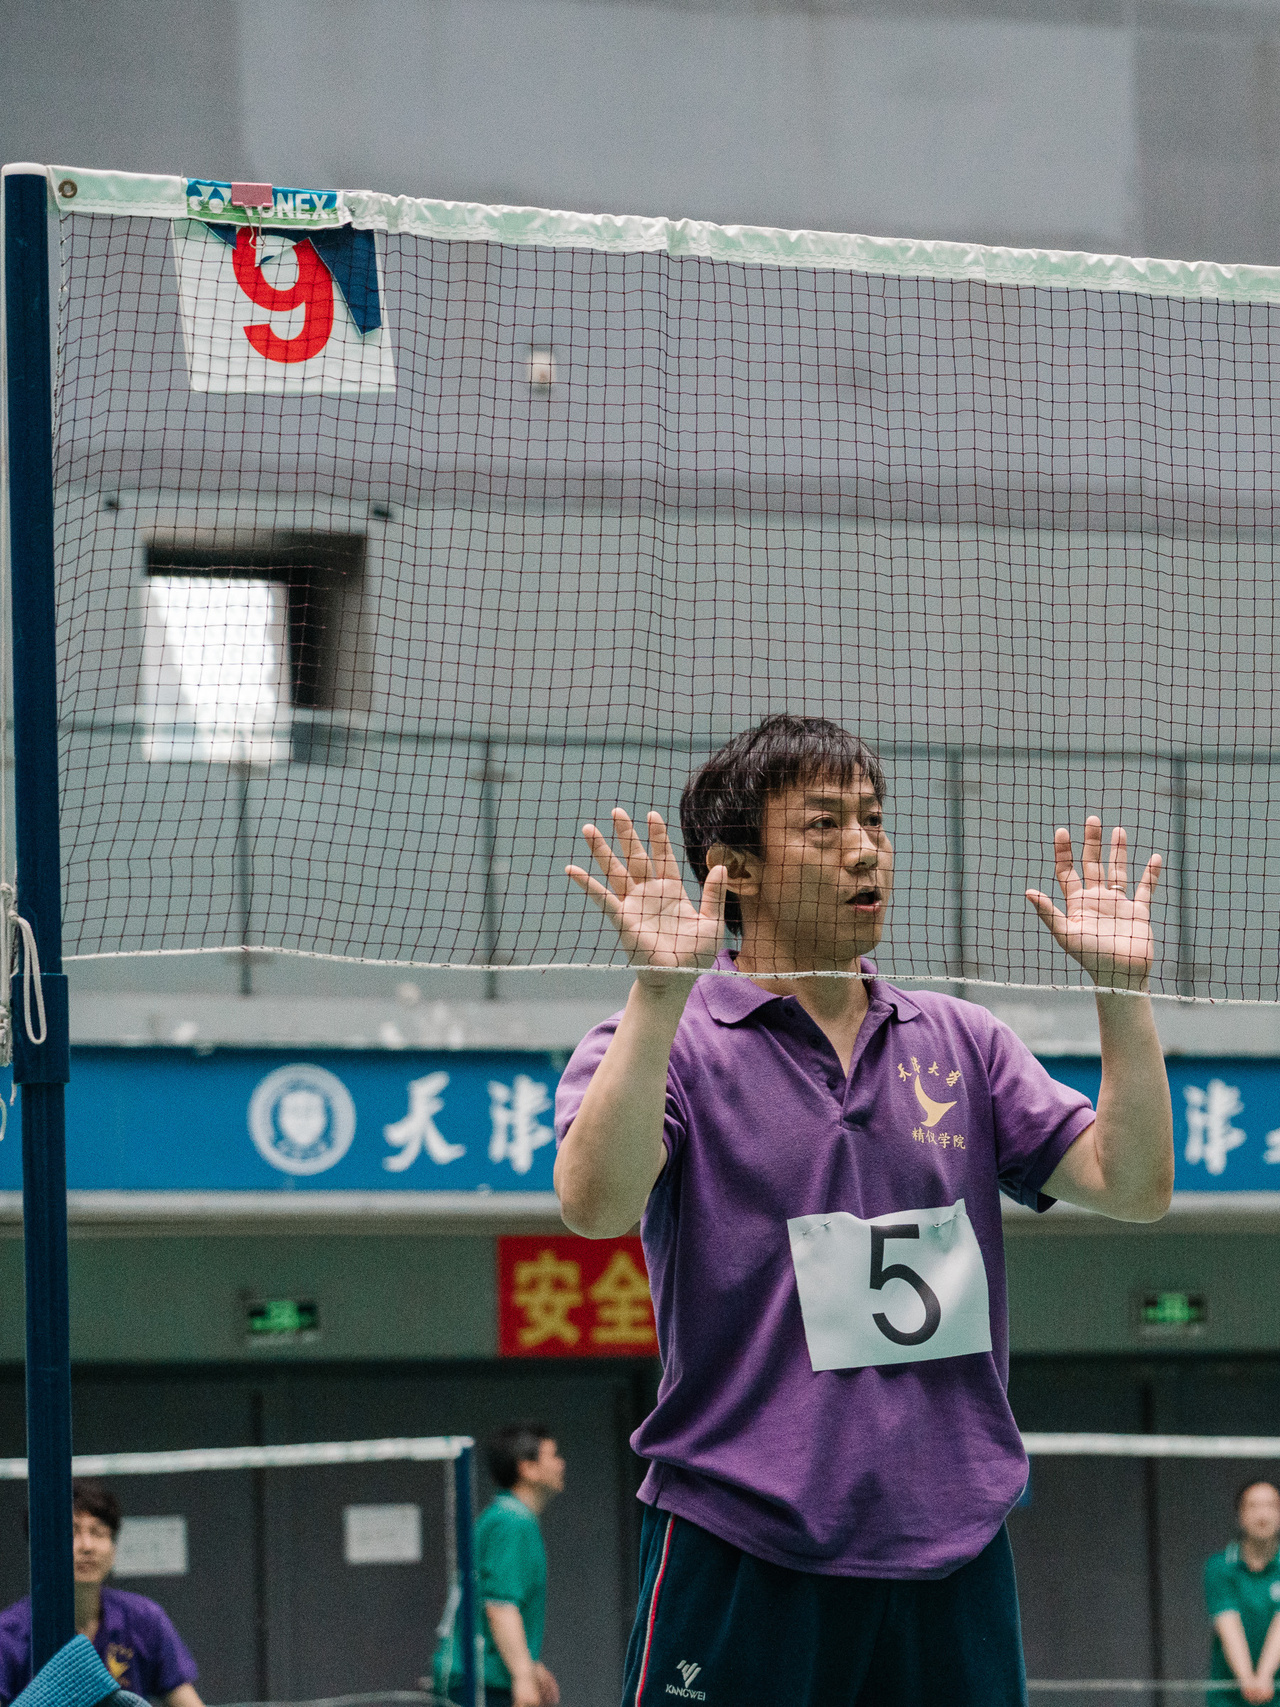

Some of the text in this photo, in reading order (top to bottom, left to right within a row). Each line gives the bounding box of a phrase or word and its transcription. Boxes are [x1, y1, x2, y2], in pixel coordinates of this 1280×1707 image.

[232, 226, 334, 364] 9
[897, 1056, 961, 1087] 天津大学
[912, 1127, 966, 1150] 精仪学院
[513, 1249, 656, 1348] 安全
[869, 1224, 941, 1346] 5
[665, 1684, 706, 1701] KANGWEI
